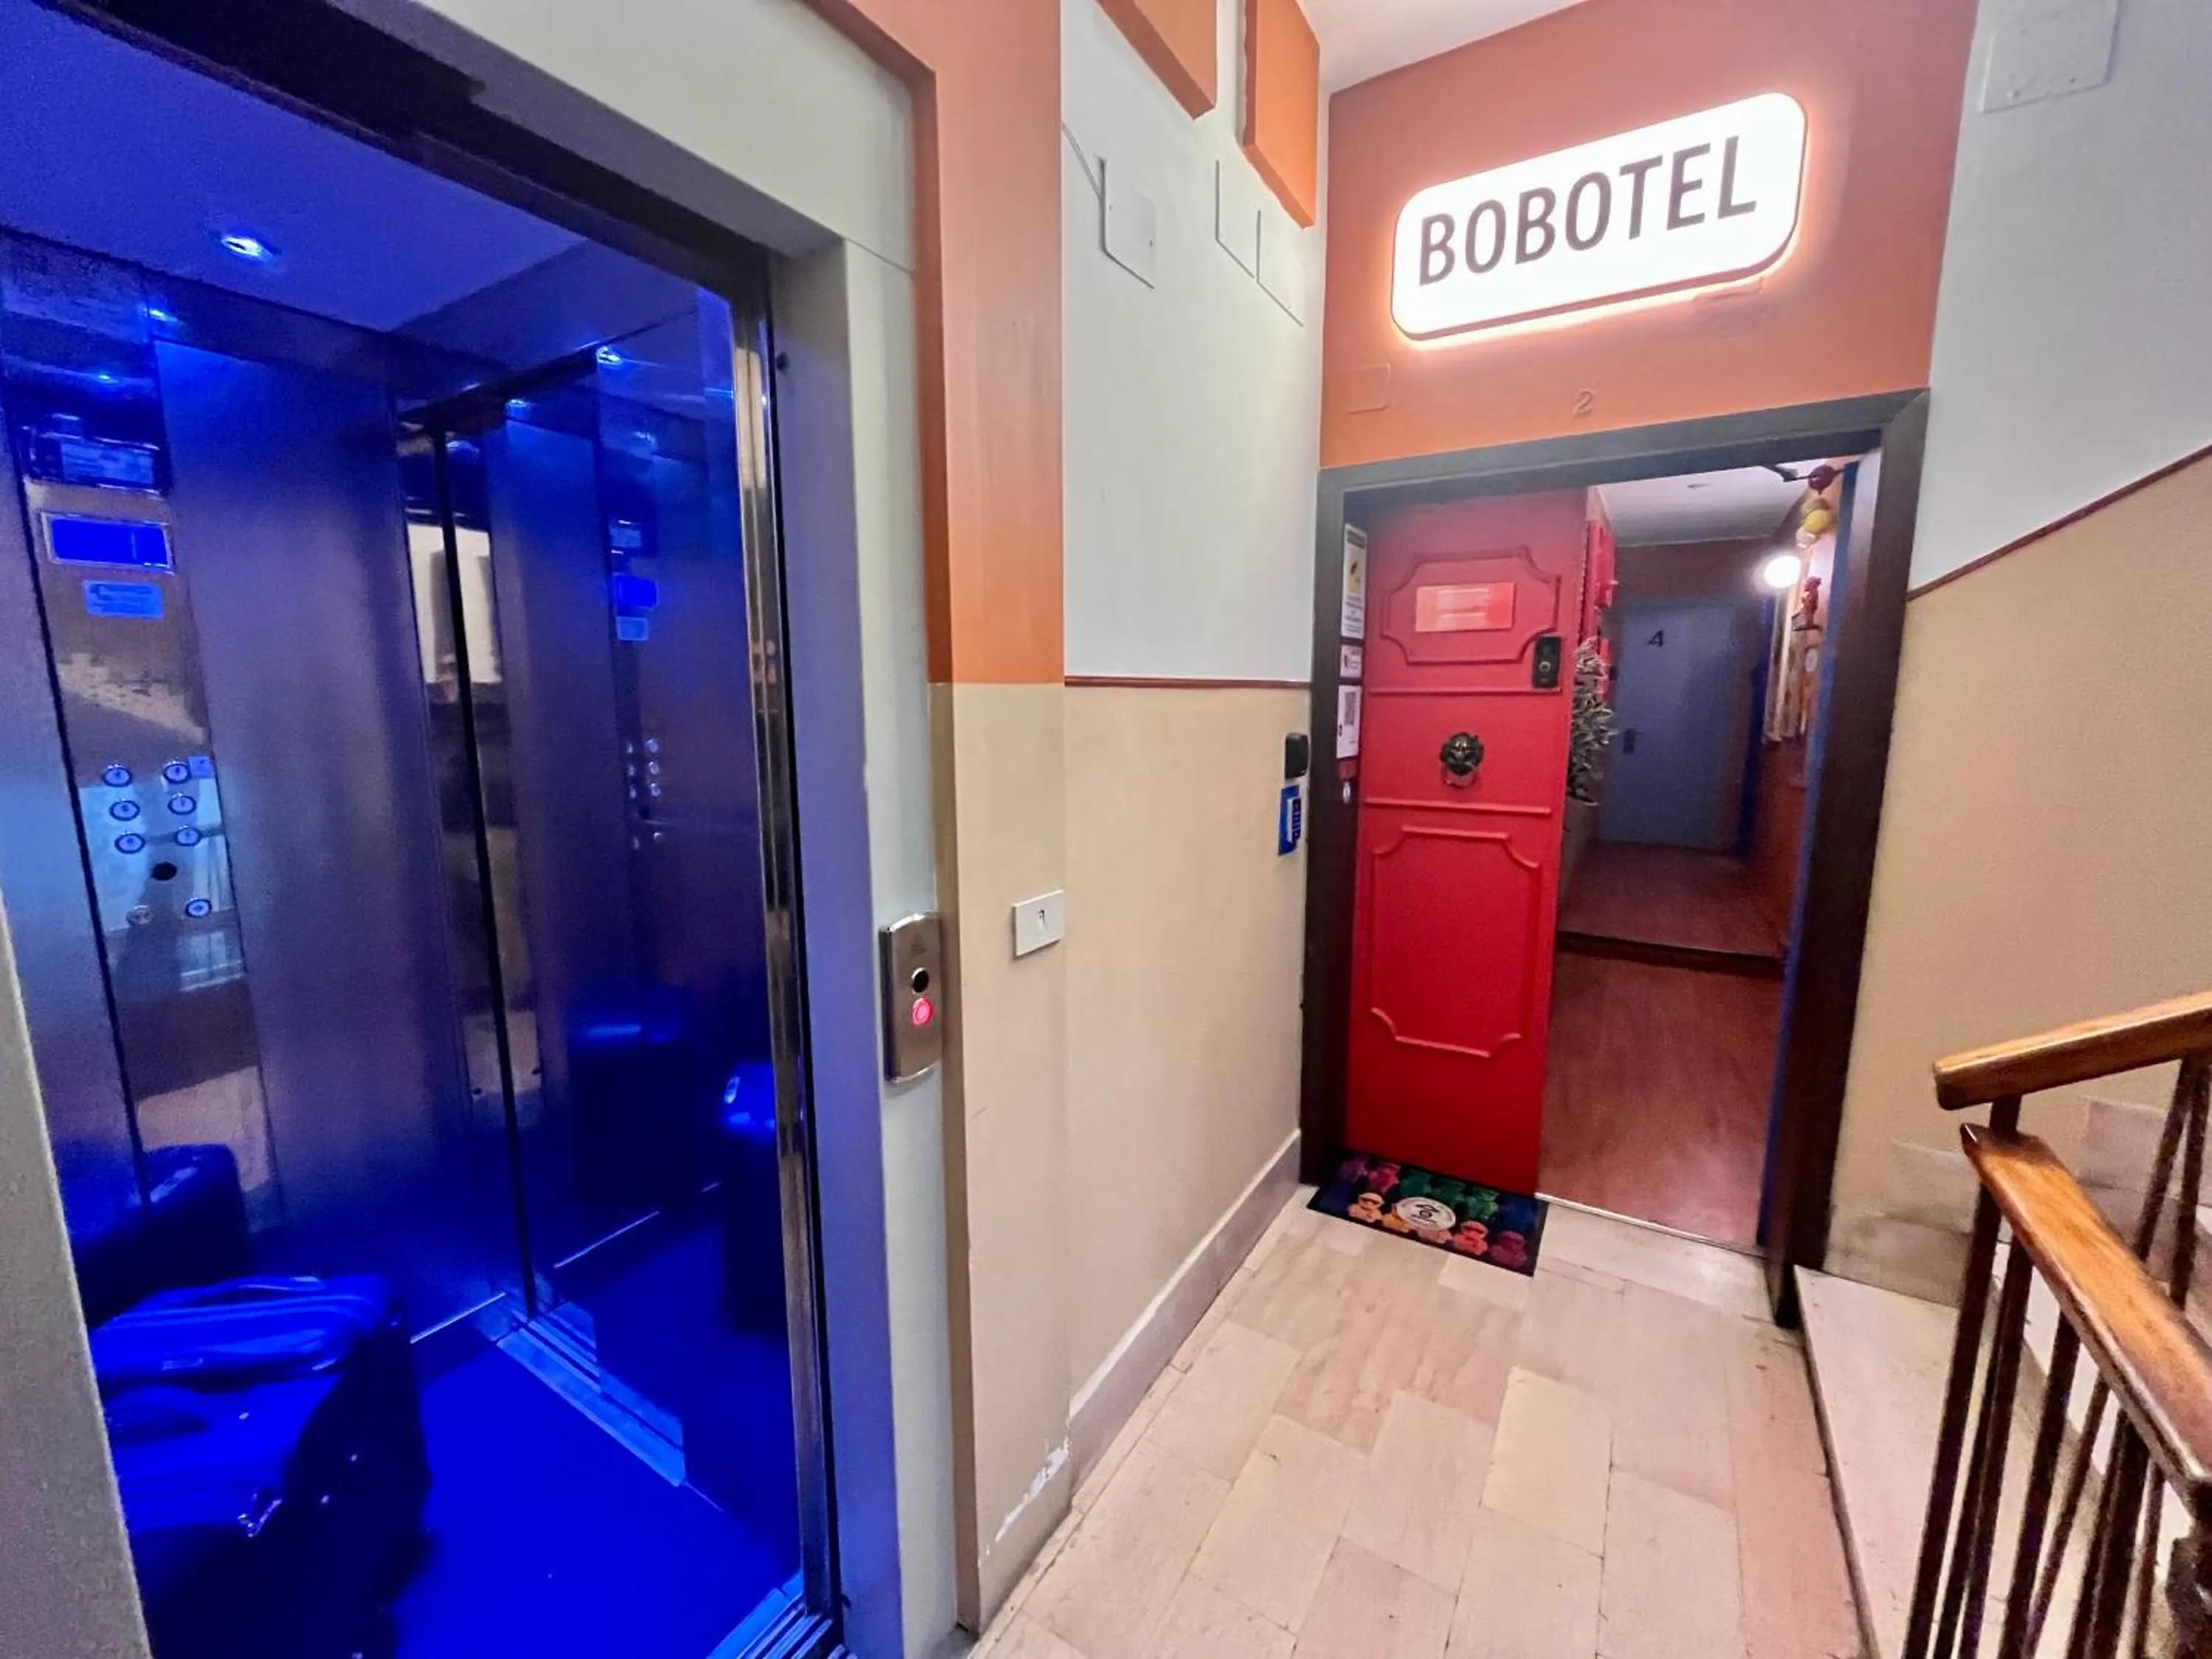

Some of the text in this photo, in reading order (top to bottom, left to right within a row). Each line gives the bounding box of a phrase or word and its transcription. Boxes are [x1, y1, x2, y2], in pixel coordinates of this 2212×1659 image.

[1419, 135, 1757, 286] BOBOTEL
[1572, 388, 1595, 417] 2
[1648, 629, 1664, 647] 4
